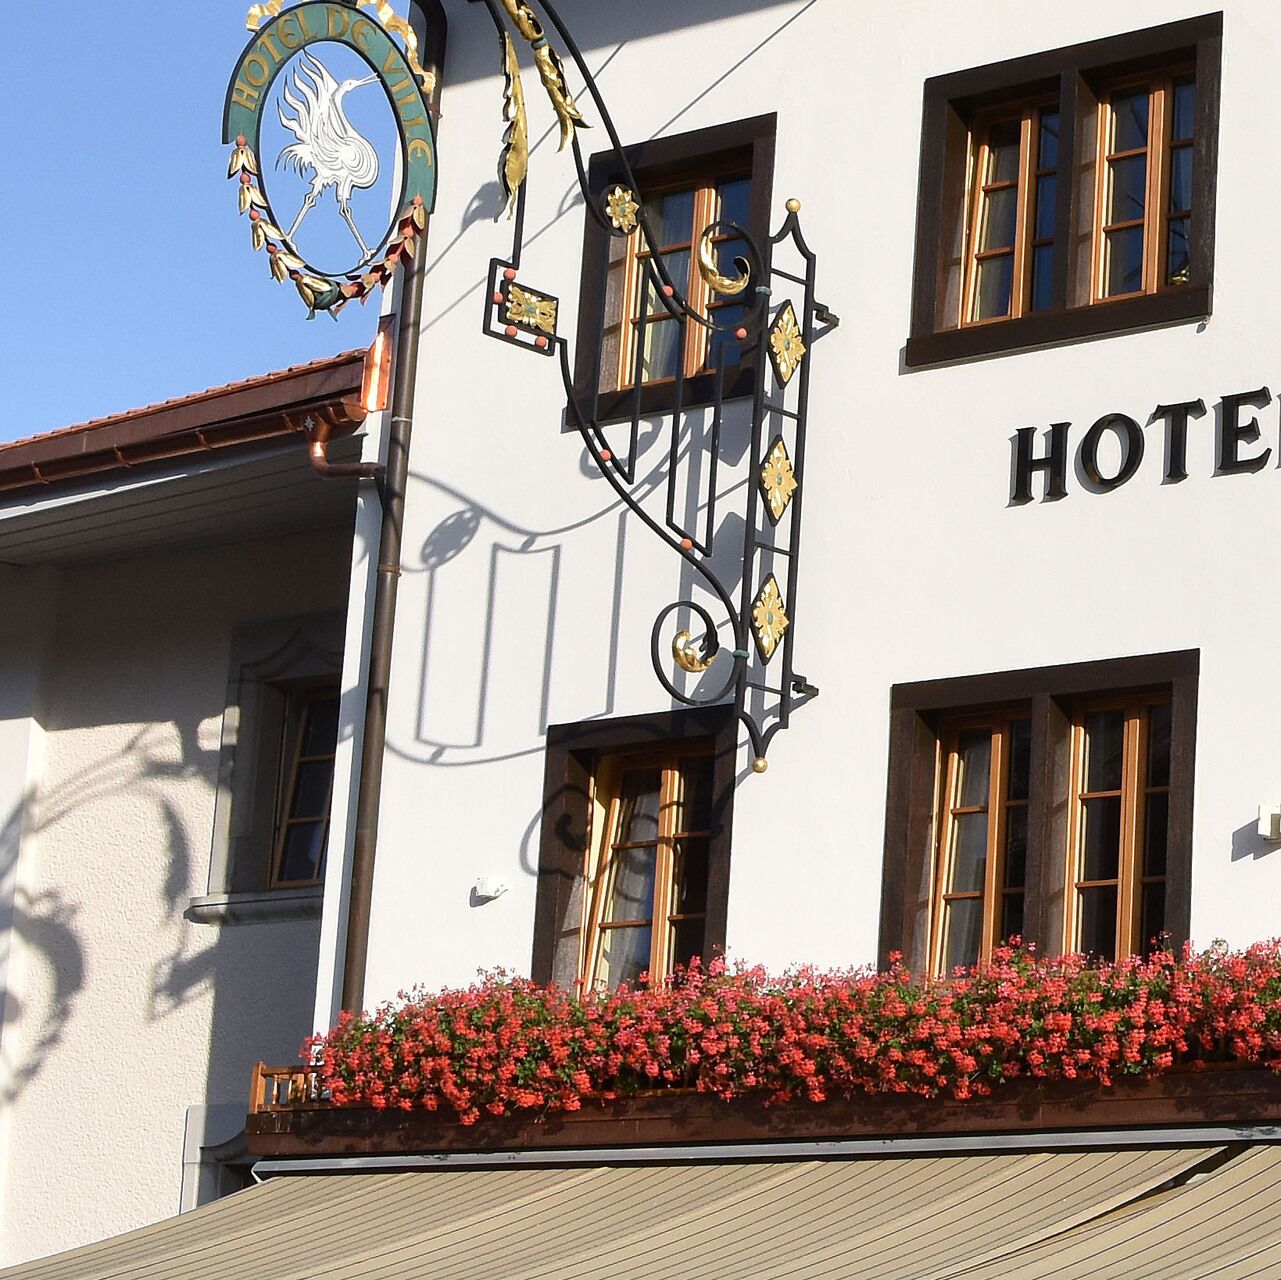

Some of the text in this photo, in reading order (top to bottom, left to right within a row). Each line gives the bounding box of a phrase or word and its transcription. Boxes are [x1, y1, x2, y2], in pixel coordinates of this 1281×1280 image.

[231, 6, 433, 167] HOTEL DE VILLE
